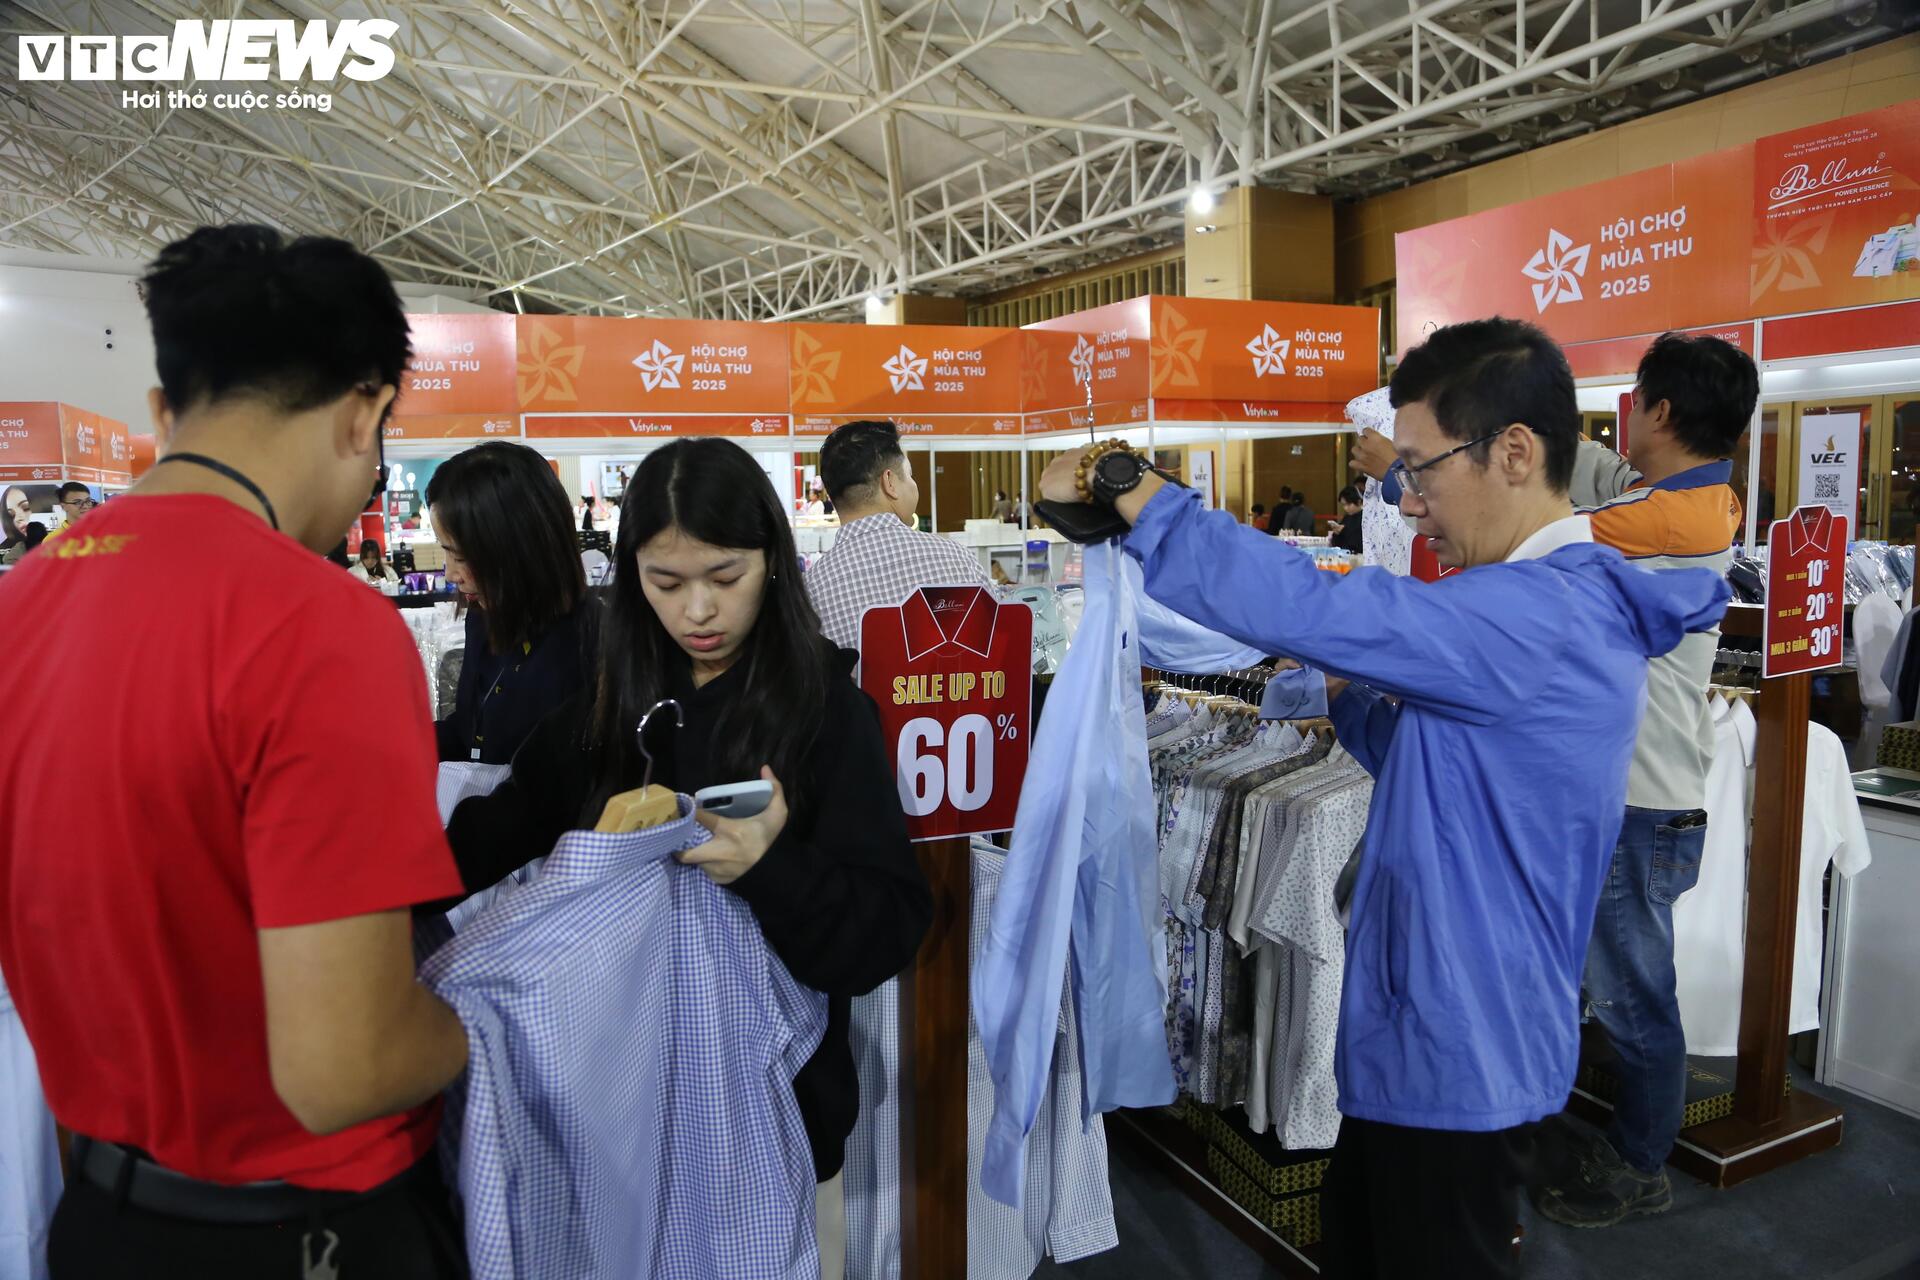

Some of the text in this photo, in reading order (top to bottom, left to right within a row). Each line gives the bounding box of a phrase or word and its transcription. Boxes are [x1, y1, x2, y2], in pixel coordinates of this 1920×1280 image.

[1835, 181, 1890, 198] POWER ESSENCE
[1847, 197, 1861, 205] NAM
[1863, 194, 1878, 202] CAO
[1601, 205, 1686, 243] HỘI CHỢ
[1601, 237, 1692, 271] MÙA THU
[1600, 274, 1651, 299] 2025
[1097, 328, 1127, 345] HỘI CHỢ
[1295, 328, 1342, 346] HỘI CHỢ
[691, 344, 748, 360] HỘI CHỢ
[933, 348, 981, 364] HỘI CHỢ
[1098, 346, 1130, 363] MÙA THU
[1295, 345, 1345, 361] MÙA THU
[449, 360, 480, 372] THU
[692, 360, 752, 374] MÙA THU
[934, 363, 986, 377] MÙA THU
[1098, 367, 1116, 380] 2025
[1295, 365, 1324, 377] 2025
[412, 378, 452, 390] 2025
[692, 379, 727, 391] 2025
[934, 381, 965, 392] 2025
[1, 418, 24, 429] CHỢ
[7, 430, 29, 438] THU
[1811, 452, 1847, 464] VEC
[1771, 642, 1785, 656] MUA
[1786, 641, 1791, 653] 3
[1792, 636, 1808, 652] GIẢM
[892, 670, 1005, 705] SALE UP TO
